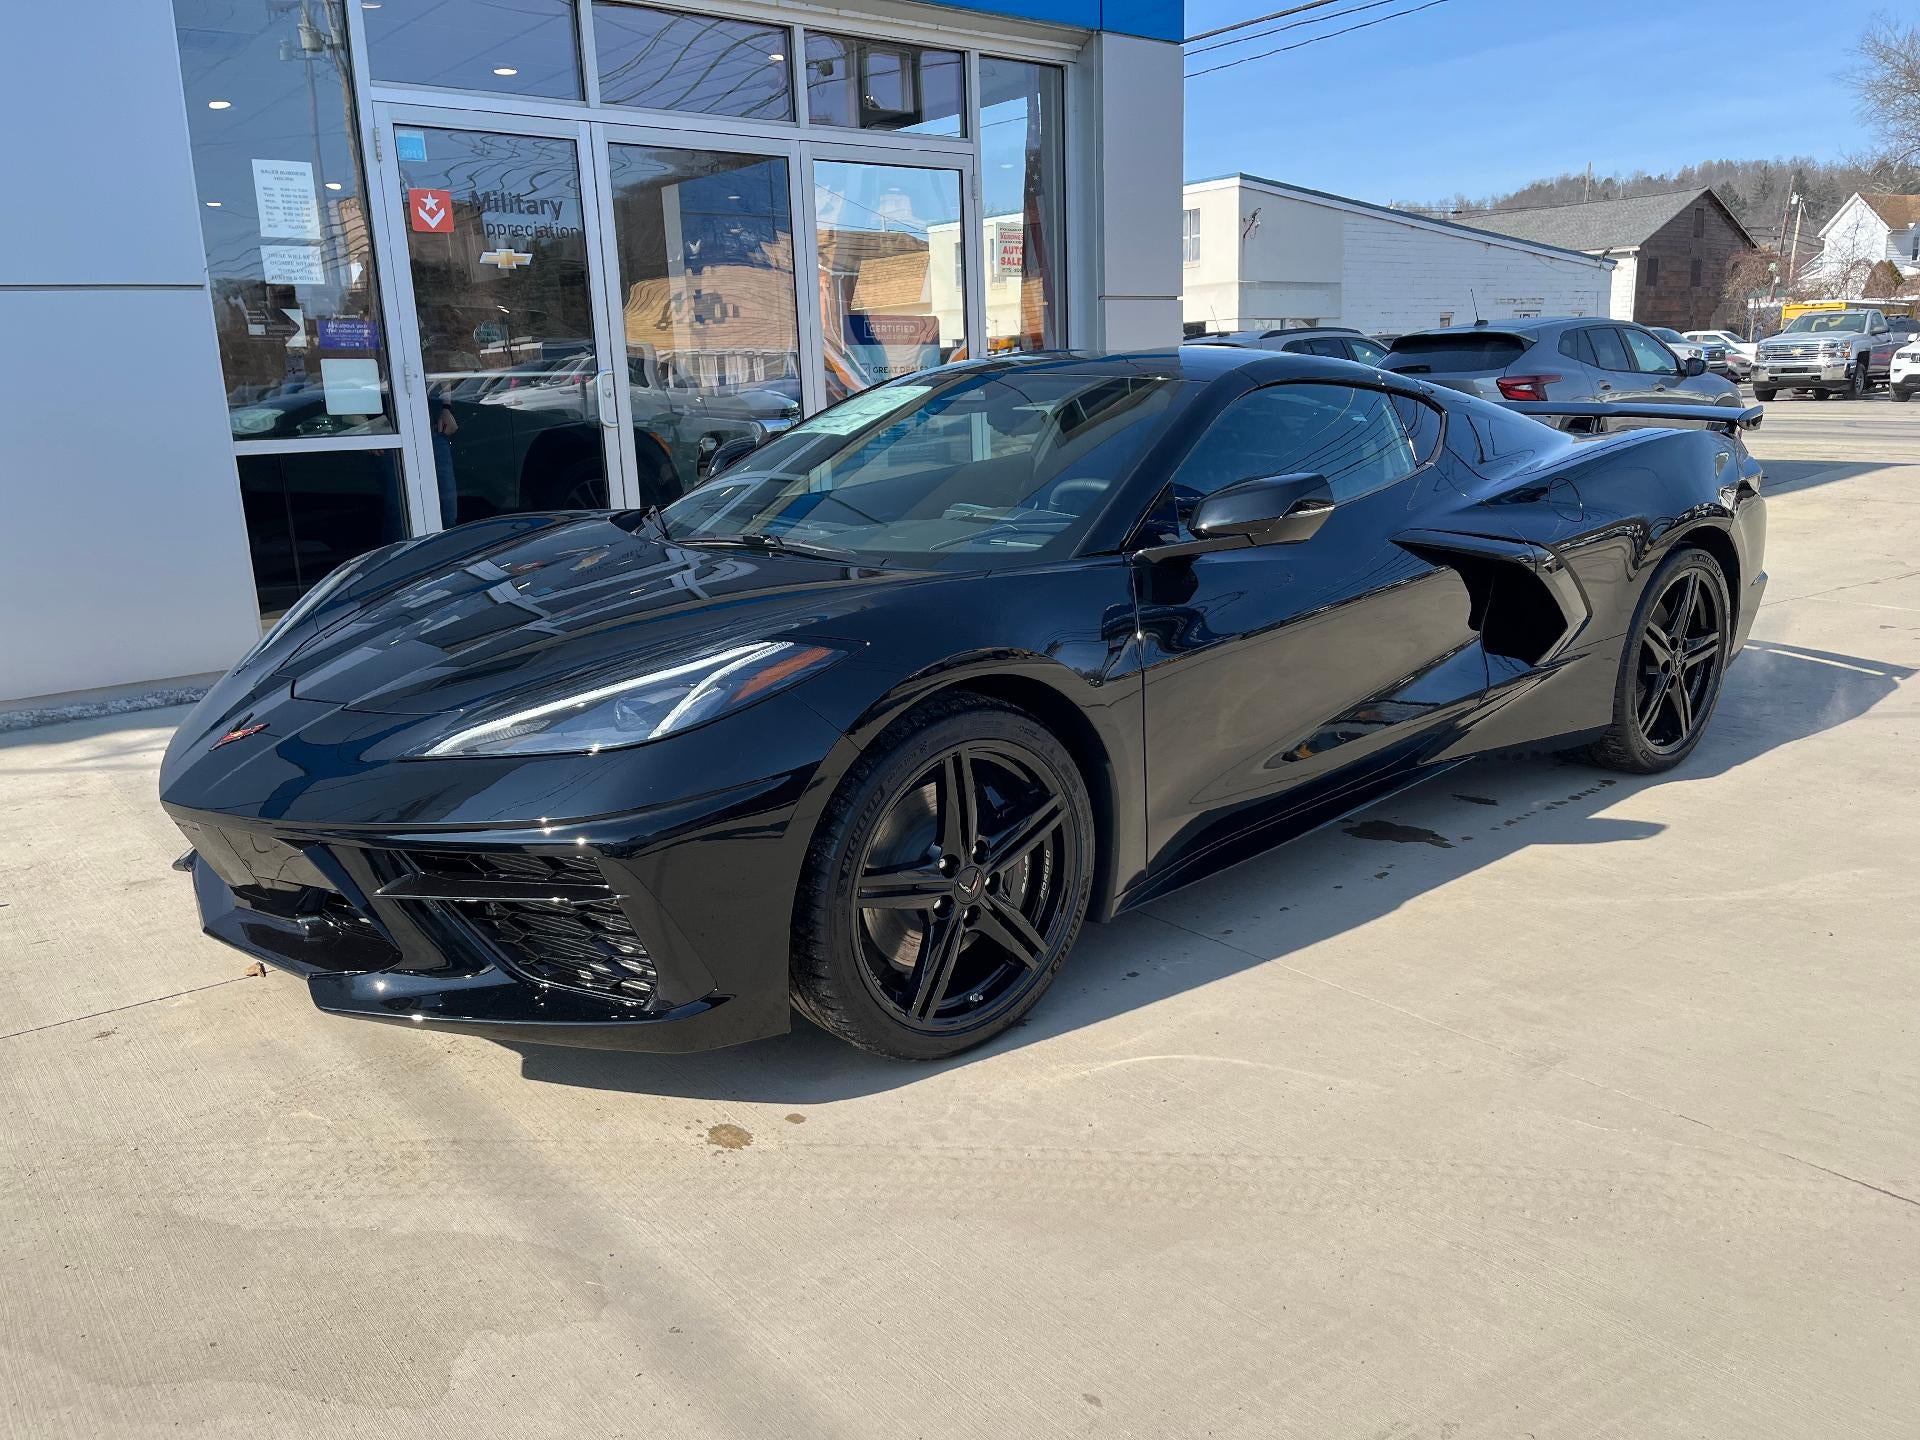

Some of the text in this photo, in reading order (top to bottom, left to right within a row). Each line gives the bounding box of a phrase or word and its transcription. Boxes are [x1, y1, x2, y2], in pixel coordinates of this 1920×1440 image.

[468, 190, 563, 221] Military
[484, 220, 579, 241] ppreciation
[869, 324, 916, 333] CERTIFIED
